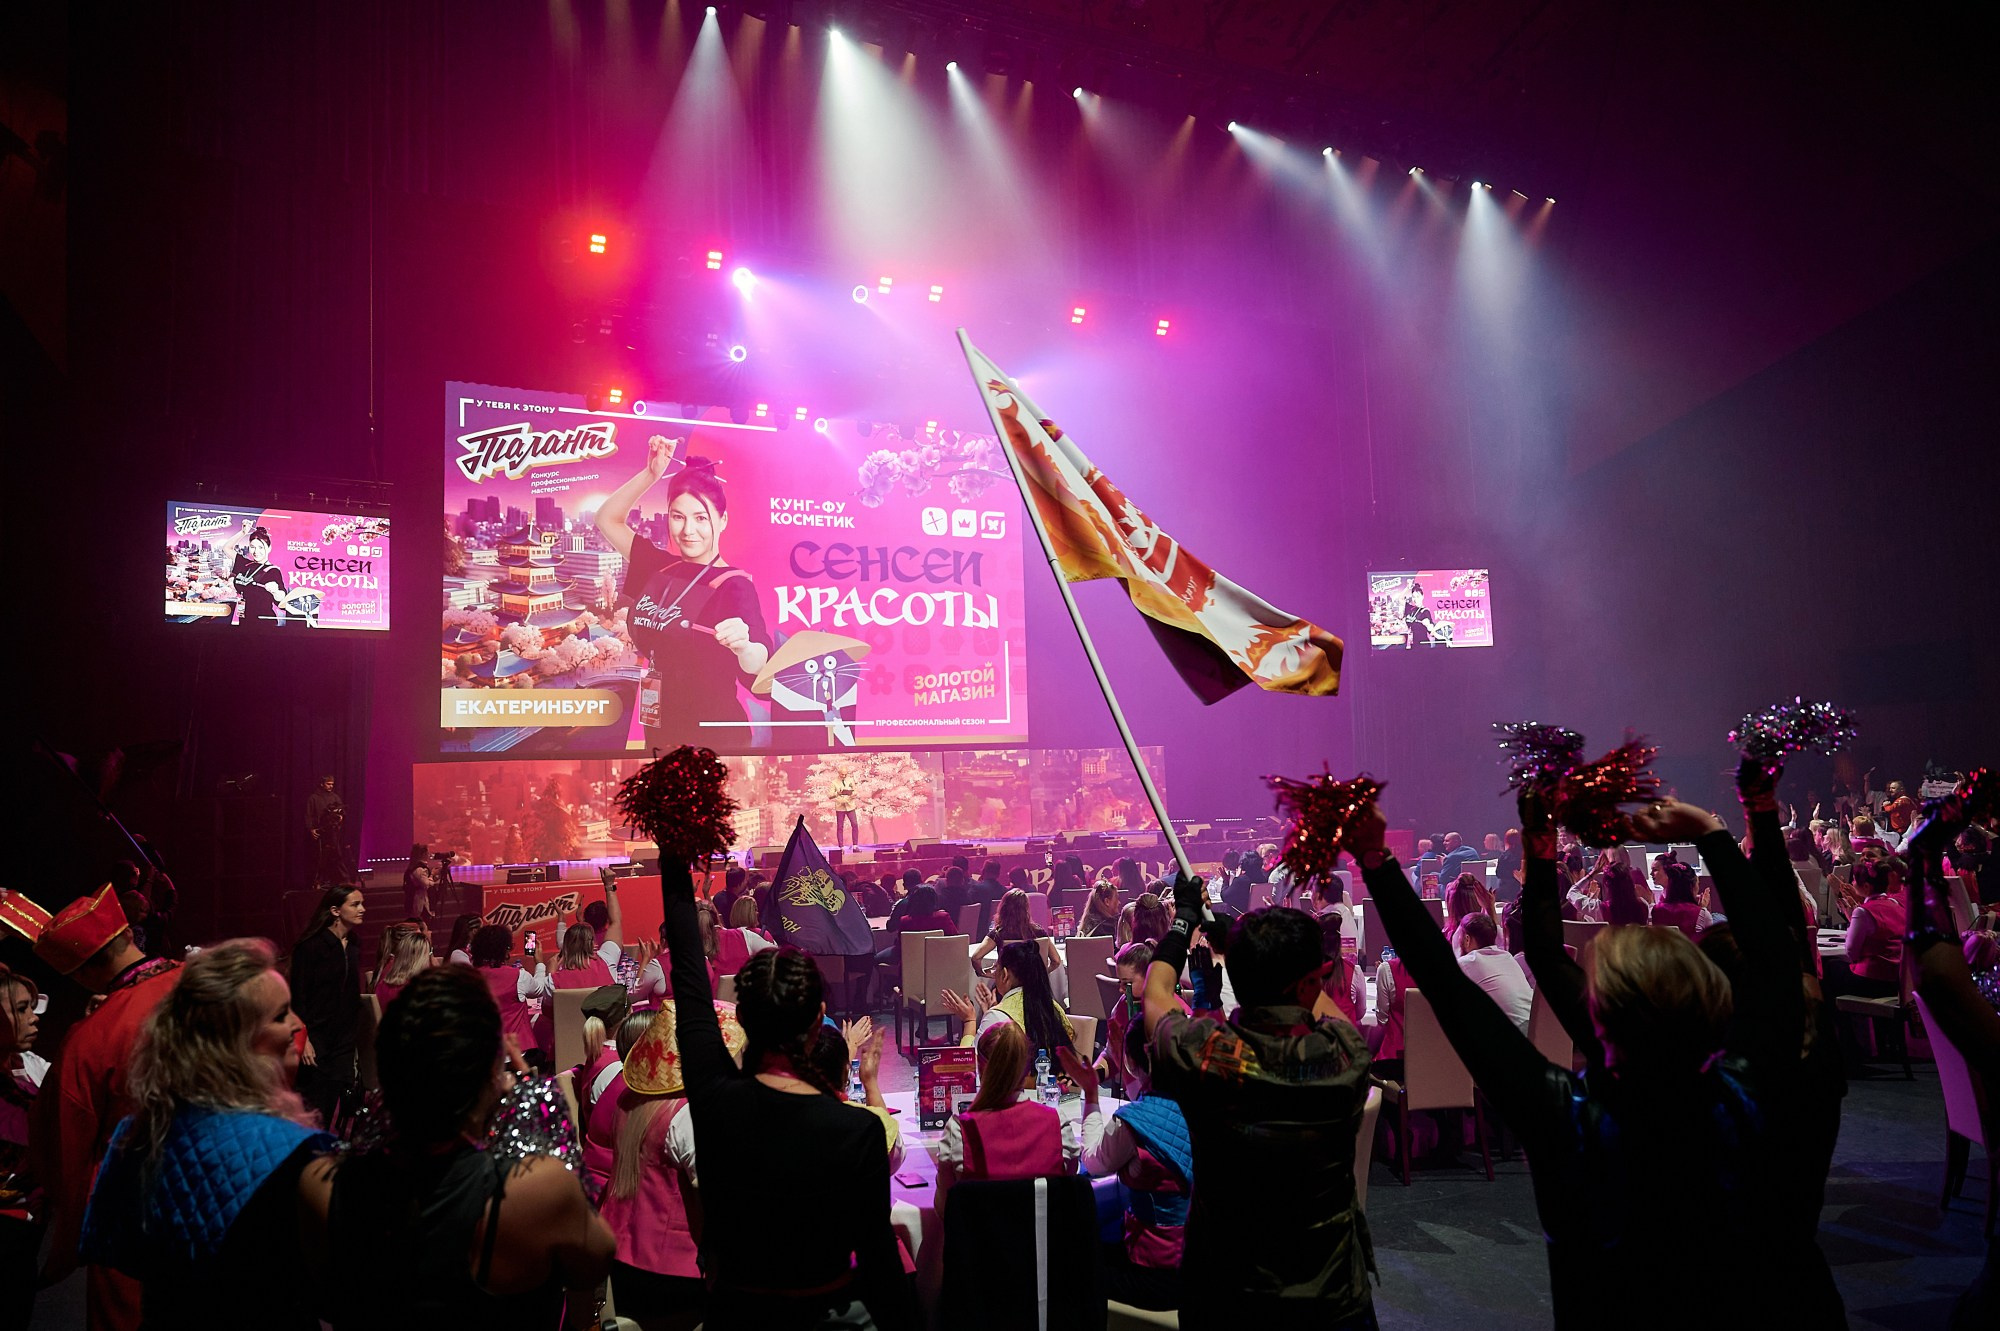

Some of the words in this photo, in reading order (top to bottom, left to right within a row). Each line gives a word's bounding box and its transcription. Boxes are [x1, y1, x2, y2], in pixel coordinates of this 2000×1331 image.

[476, 399, 483, 407] У
[485, 400, 511, 410] ТЕБЯ
[513, 403, 520, 411] К
[522, 404, 555, 414] ЭТОМУ
[531, 471, 560, 479] Конкурс
[531, 474, 600, 487] профессионального
[531, 485, 570, 495] мастерства
[769, 497, 846, 514] КУНГ-ФУ
[770, 512, 855, 529] КОСМЕТИК
[287, 571, 378, 589] КРАСОТЫ
[774, 585, 999, 629] КРАСОТЫ
[1433, 609, 1485, 621] КРАСОТЫ
[914, 662, 995, 690] ЗОЛОТОЙ
[914, 684, 995, 707] МАГАЗИН
[455, 699, 610, 715] ЕКАТЕРИНБУРГ
[875, 717, 960, 727] ПРОФЕССИОНАЛЬНЫЙ
